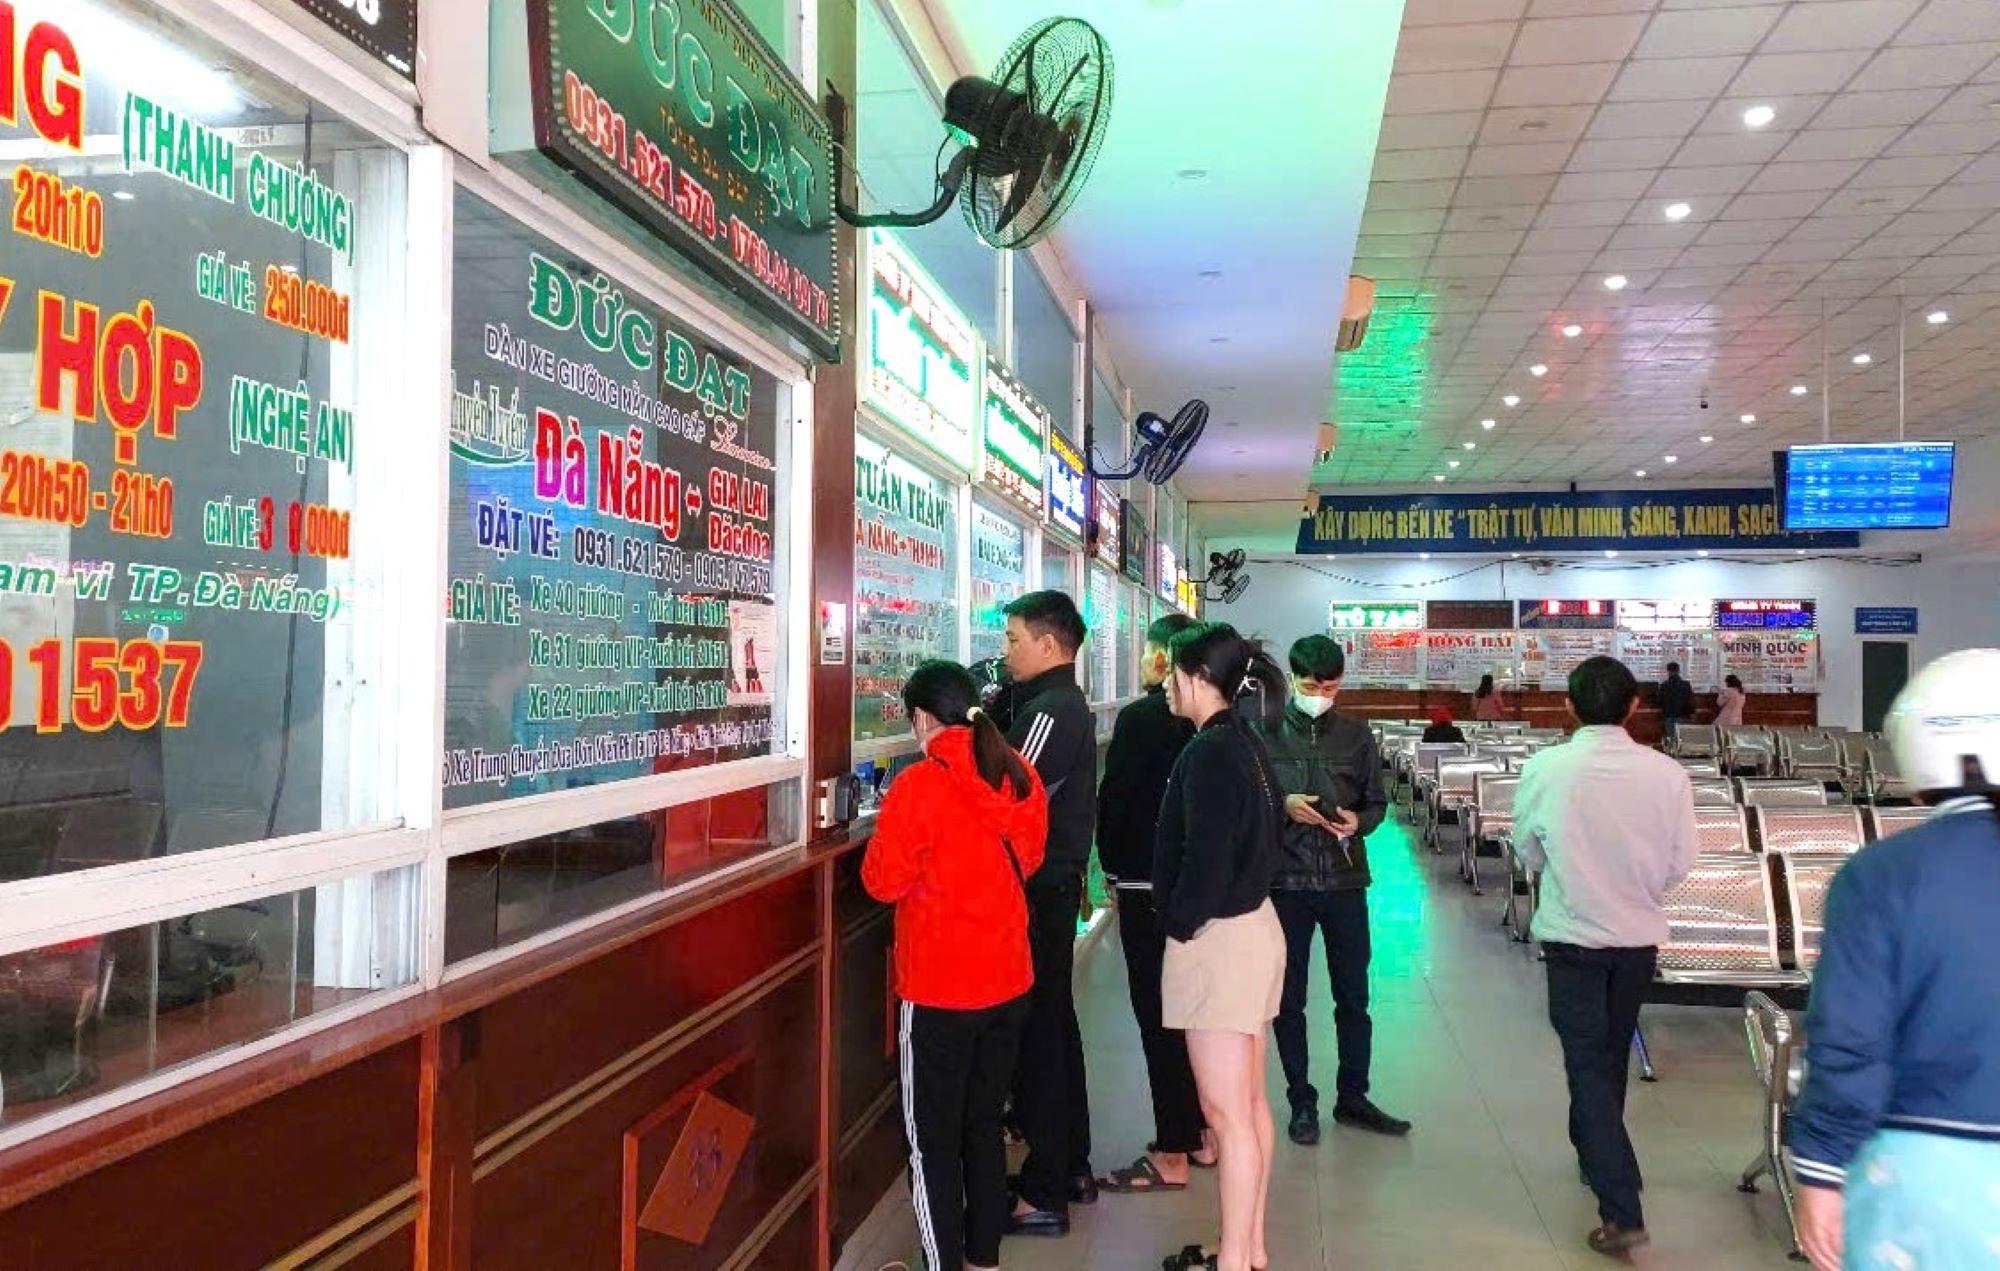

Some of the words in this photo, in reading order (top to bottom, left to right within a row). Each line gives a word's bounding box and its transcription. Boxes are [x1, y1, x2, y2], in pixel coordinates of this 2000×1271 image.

[123, 91, 235, 204] (THANH
[13, 163, 103, 258] 20h10
[198, 251, 227, 304] GIÁ
[528, 252, 654, 371] ĐỨC
[663, 329, 751, 421] ĐẠT
[37, 288, 203, 466] HỢP
[528, 343, 555, 383] XE
[231, 374, 311, 475] (NGHỆ
[313, 400, 354, 475] AN)
[0, 451, 89, 528] 20h50
[534, 406, 587, 509] Đà
[597, 424, 682, 541] Nẵng
[709, 467, 740, 513] GIA
[742, 477, 769, 520] LAI
[204, 495, 233, 547] GIÁ
[476, 500, 524, 560] ĐẶT
[573, 525, 683, 584] 0931.621.579
[1314, 506, 1344, 541] XÂY
[1348, 506, 1394, 546] DỰNG
[1396, 502, 1430, 539] BẾN
[1433, 509, 1454, 539] XE
[73, 561, 115, 601] vi
[451, 572, 488, 624] GIÁ
[530, 574, 552, 613] Xe
[554, 578, 574, 616] 40
[528, 629, 551, 667] Xe
[553, 631, 572, 669] 31
[1724, 642, 1761, 653] MINH
[527, 683, 549, 721] Xe
[551, 684, 572, 720] 22
[451, 750, 472, 786] Xe
[472, 748, 508, 788] Trung
